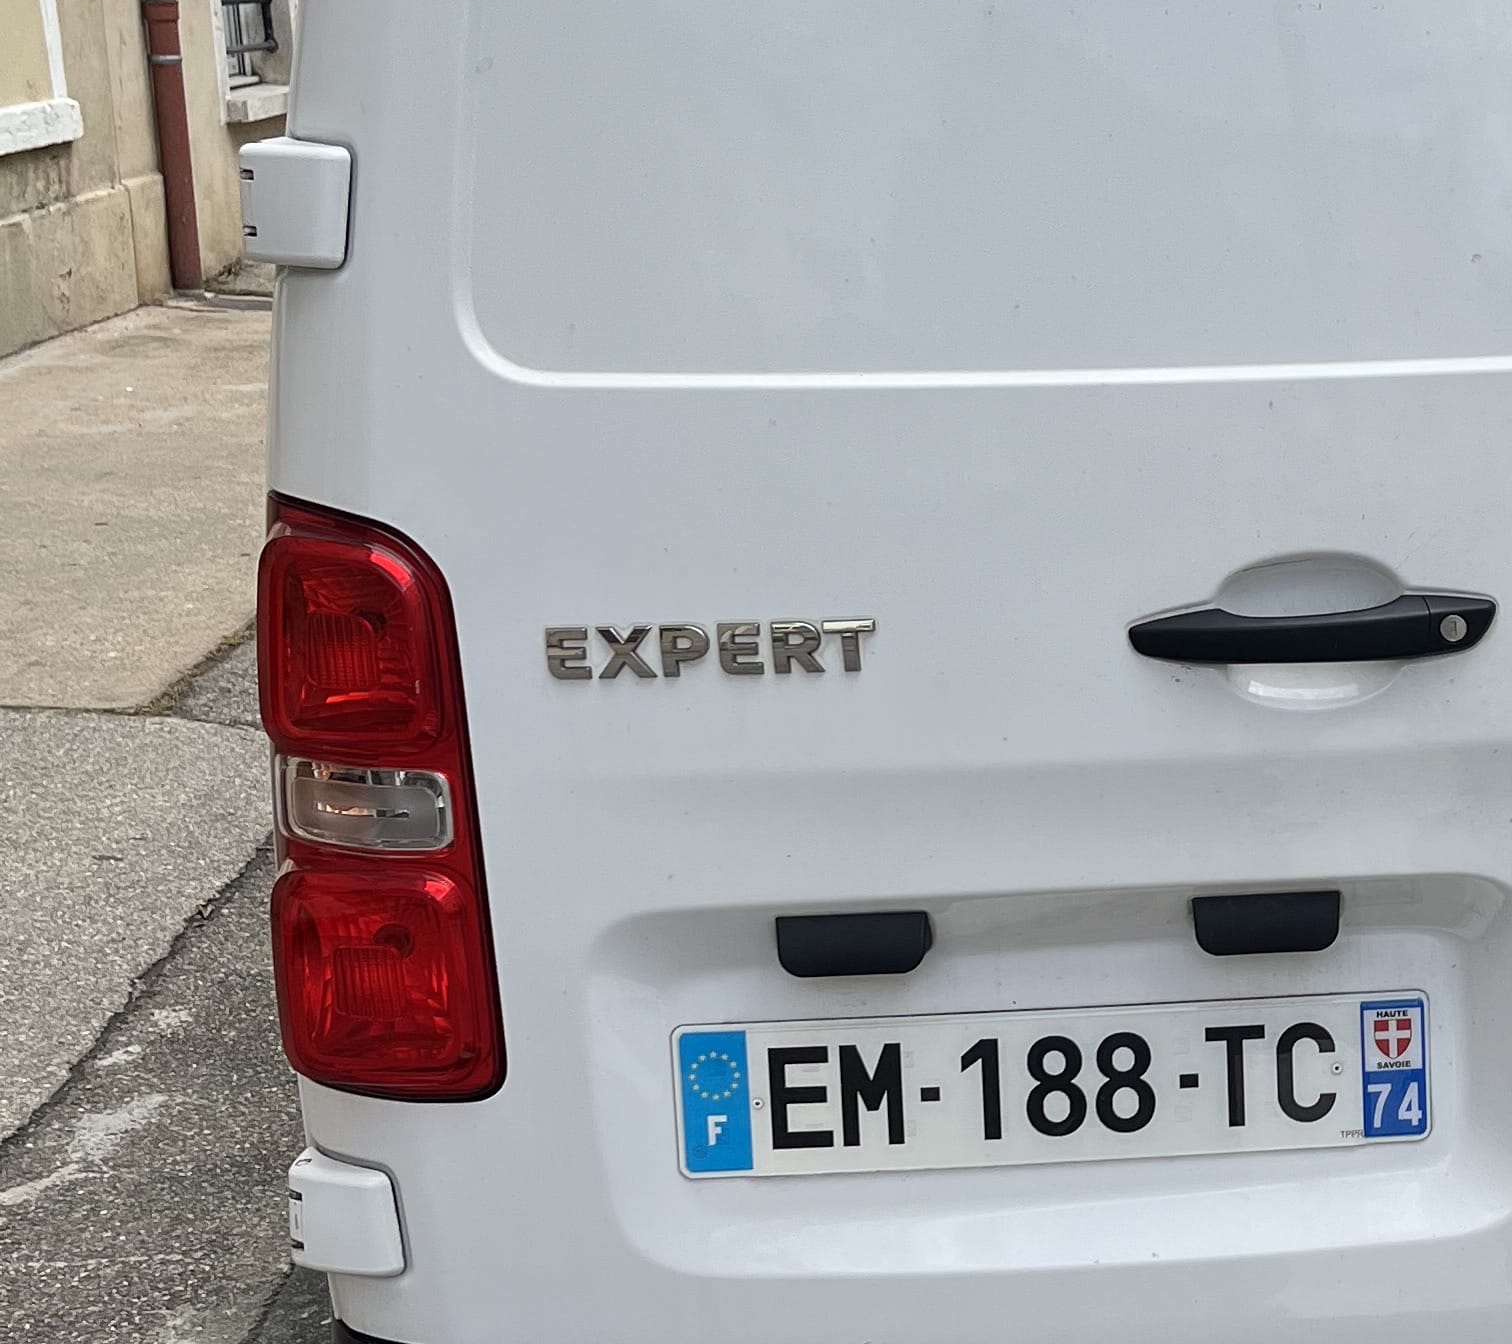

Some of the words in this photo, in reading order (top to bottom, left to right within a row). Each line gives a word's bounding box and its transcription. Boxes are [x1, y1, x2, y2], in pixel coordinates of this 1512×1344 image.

[544, 618, 877, 681] EXPERT
[1376, 1009, 1409, 1019] HAUTE
[1376, 1059, 1412, 1069] SAVOIE
[767, 1022, 1337, 1150] EM-188-TC
[1367, 1081, 1423, 1129] 74
[706, 1114, 729, 1146] F
